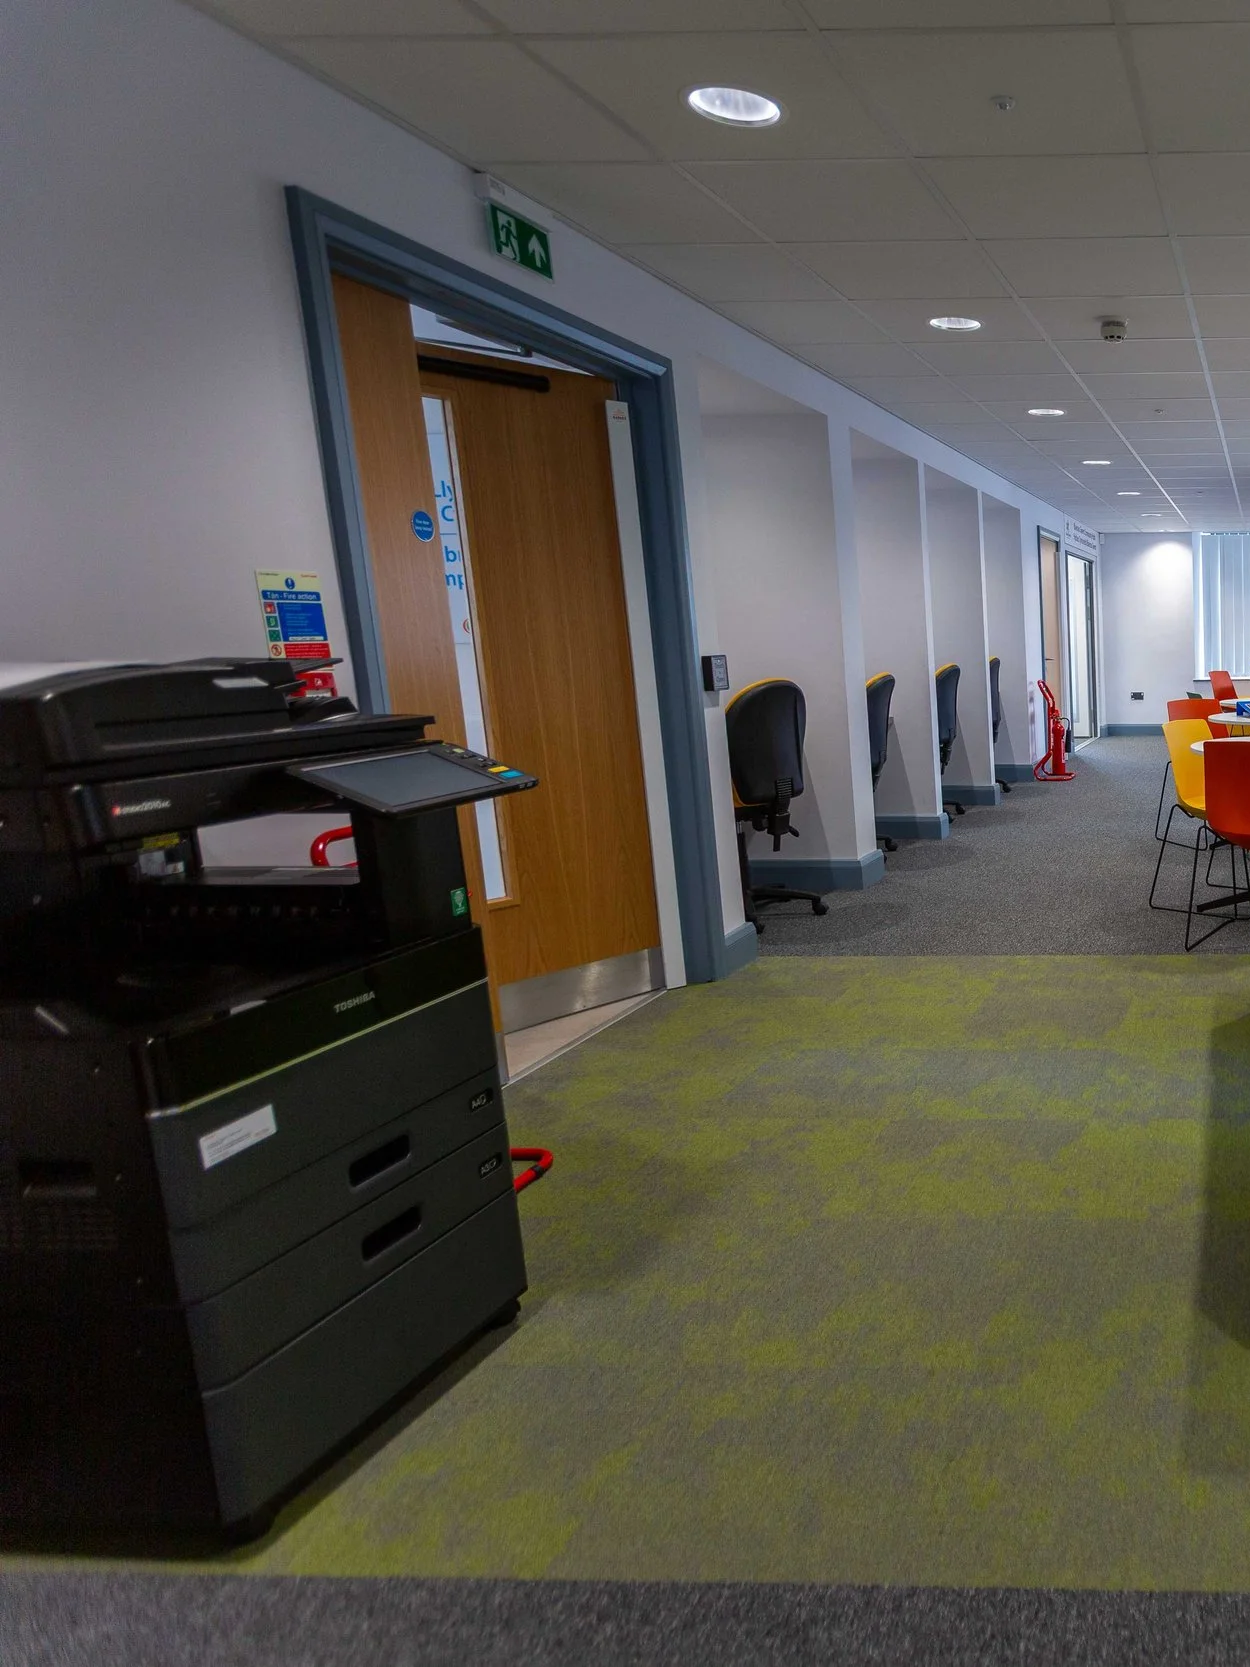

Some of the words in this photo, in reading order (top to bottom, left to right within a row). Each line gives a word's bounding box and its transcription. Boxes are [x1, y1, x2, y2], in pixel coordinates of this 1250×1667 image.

[283, 592, 297, 600] Fire
[297, 593, 317, 601] action
[333, 991, 376, 1014] TOSHIBA
